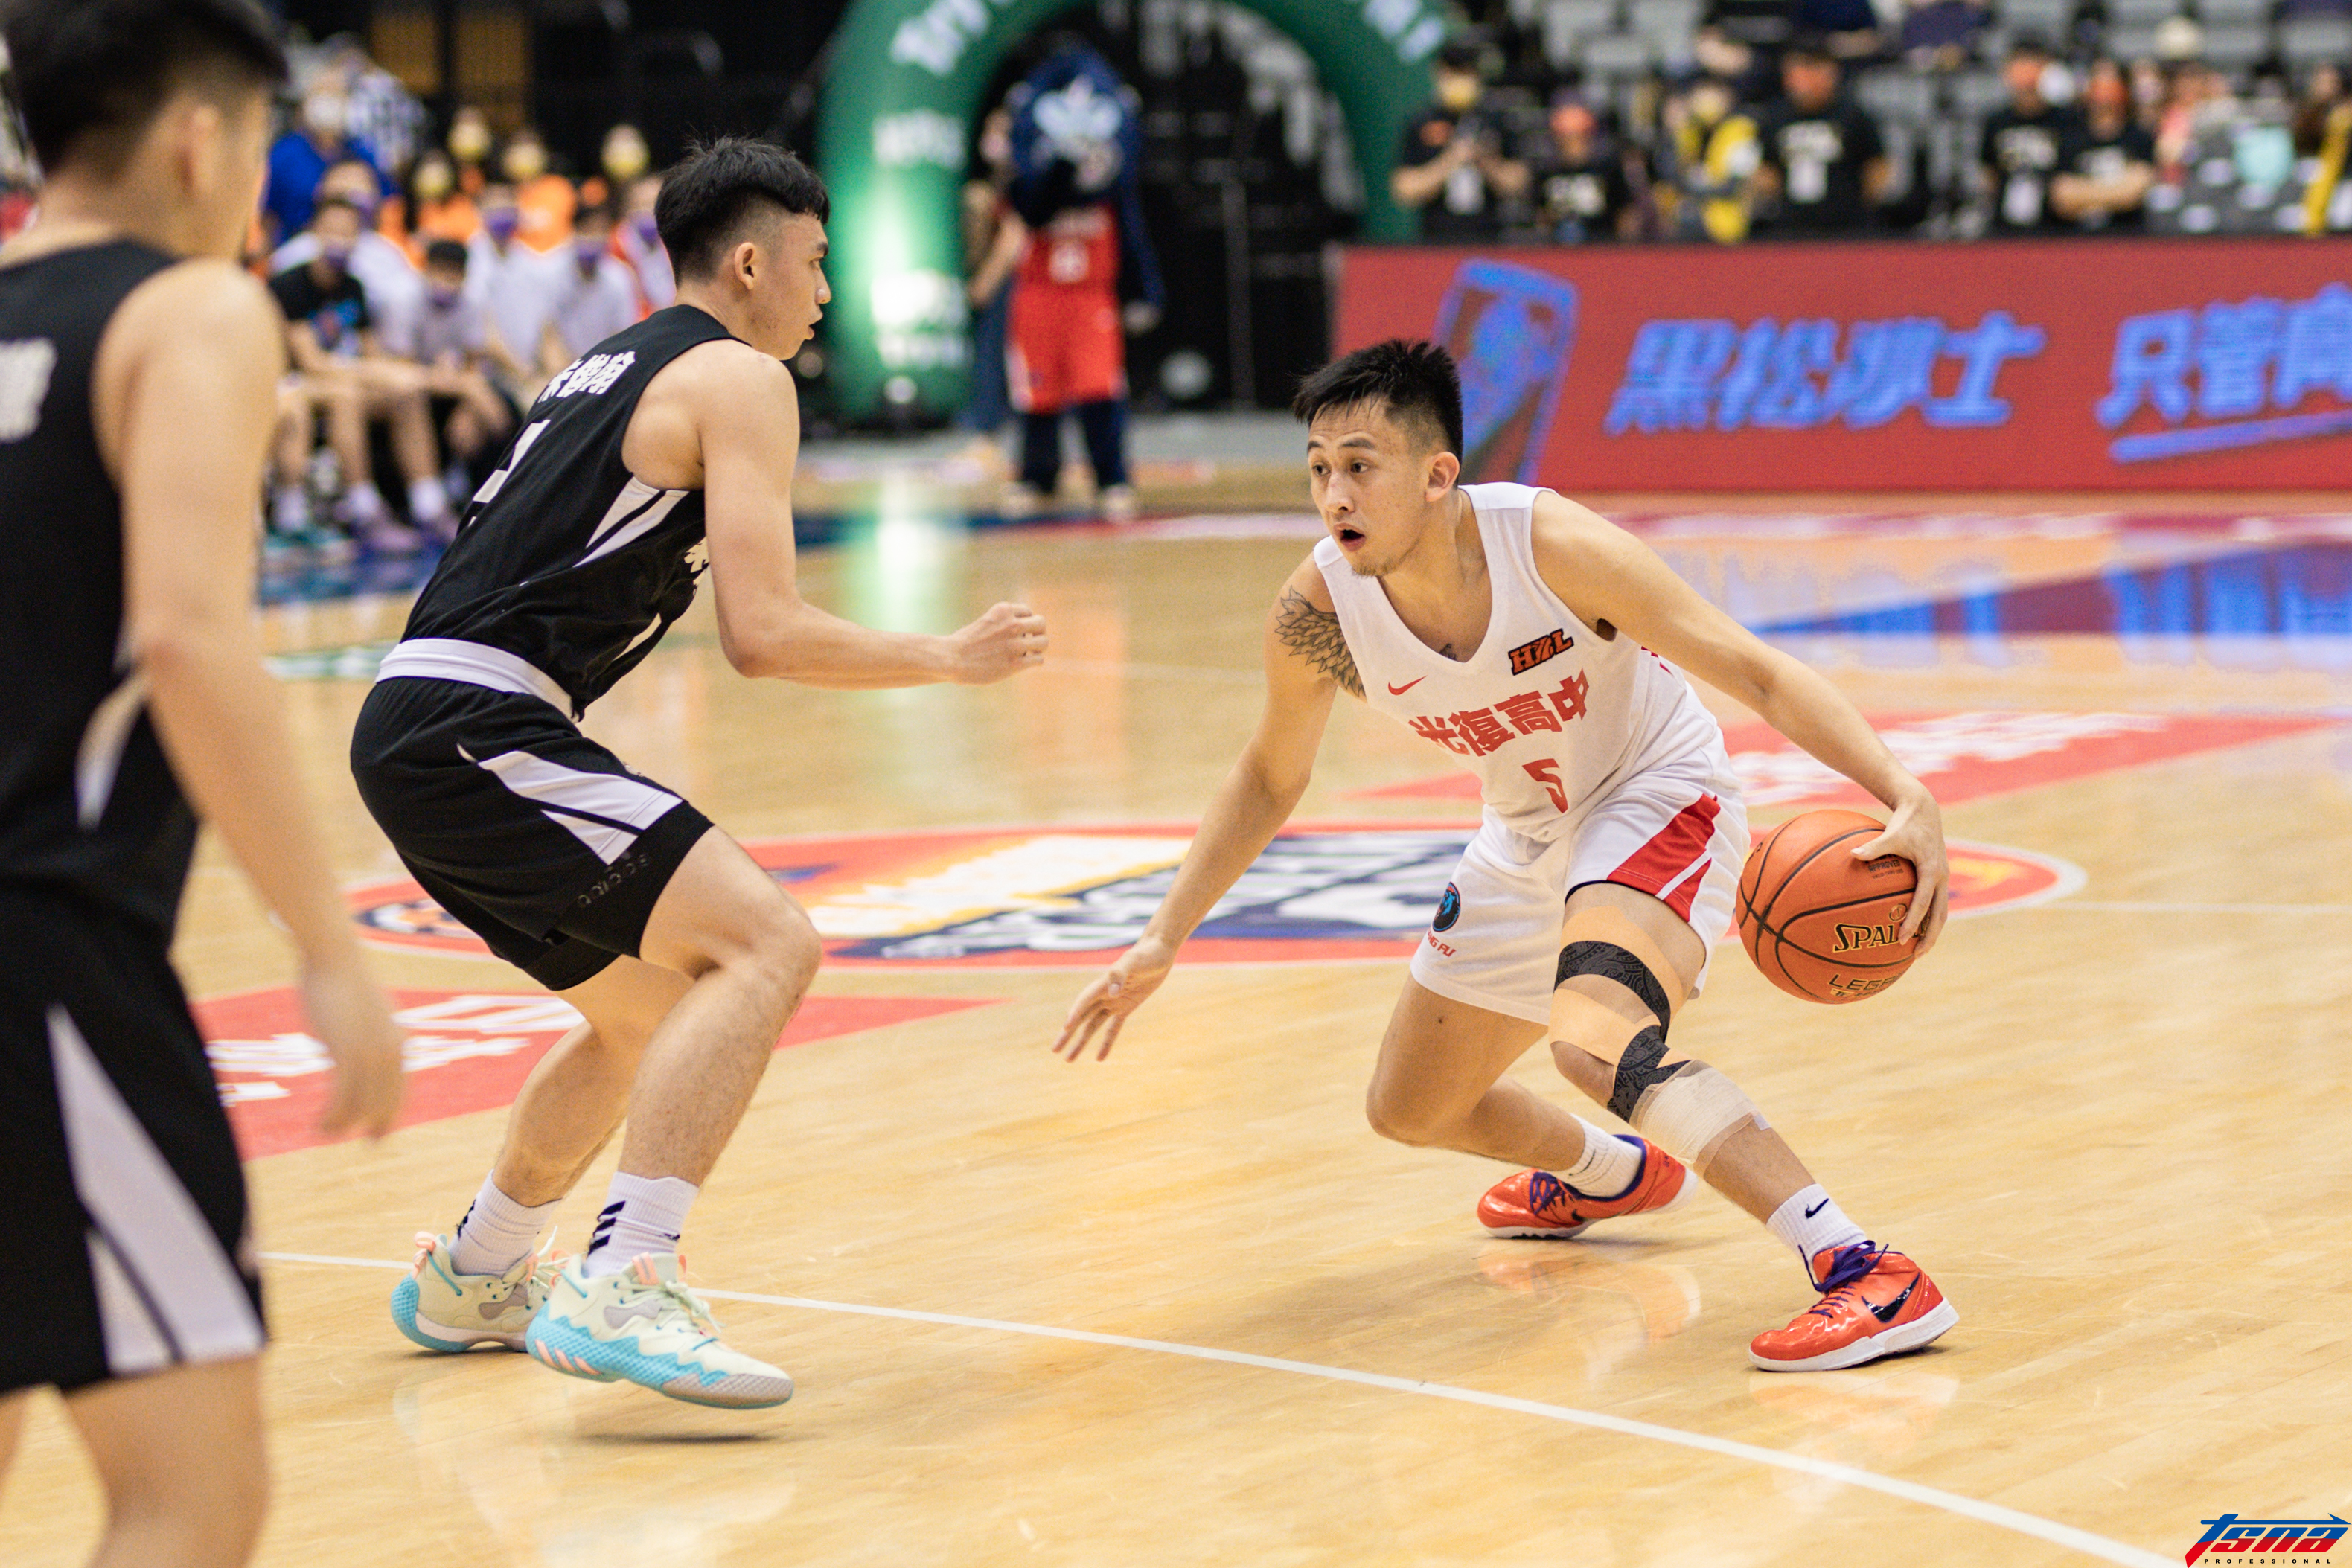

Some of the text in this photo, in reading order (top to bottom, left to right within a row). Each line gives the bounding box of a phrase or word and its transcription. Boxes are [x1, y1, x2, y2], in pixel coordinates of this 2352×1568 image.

[1407, 667, 1590, 757] 光復高中
[1521, 758, 1569, 814] 5
[1832, 922, 1920, 953] SPAL
